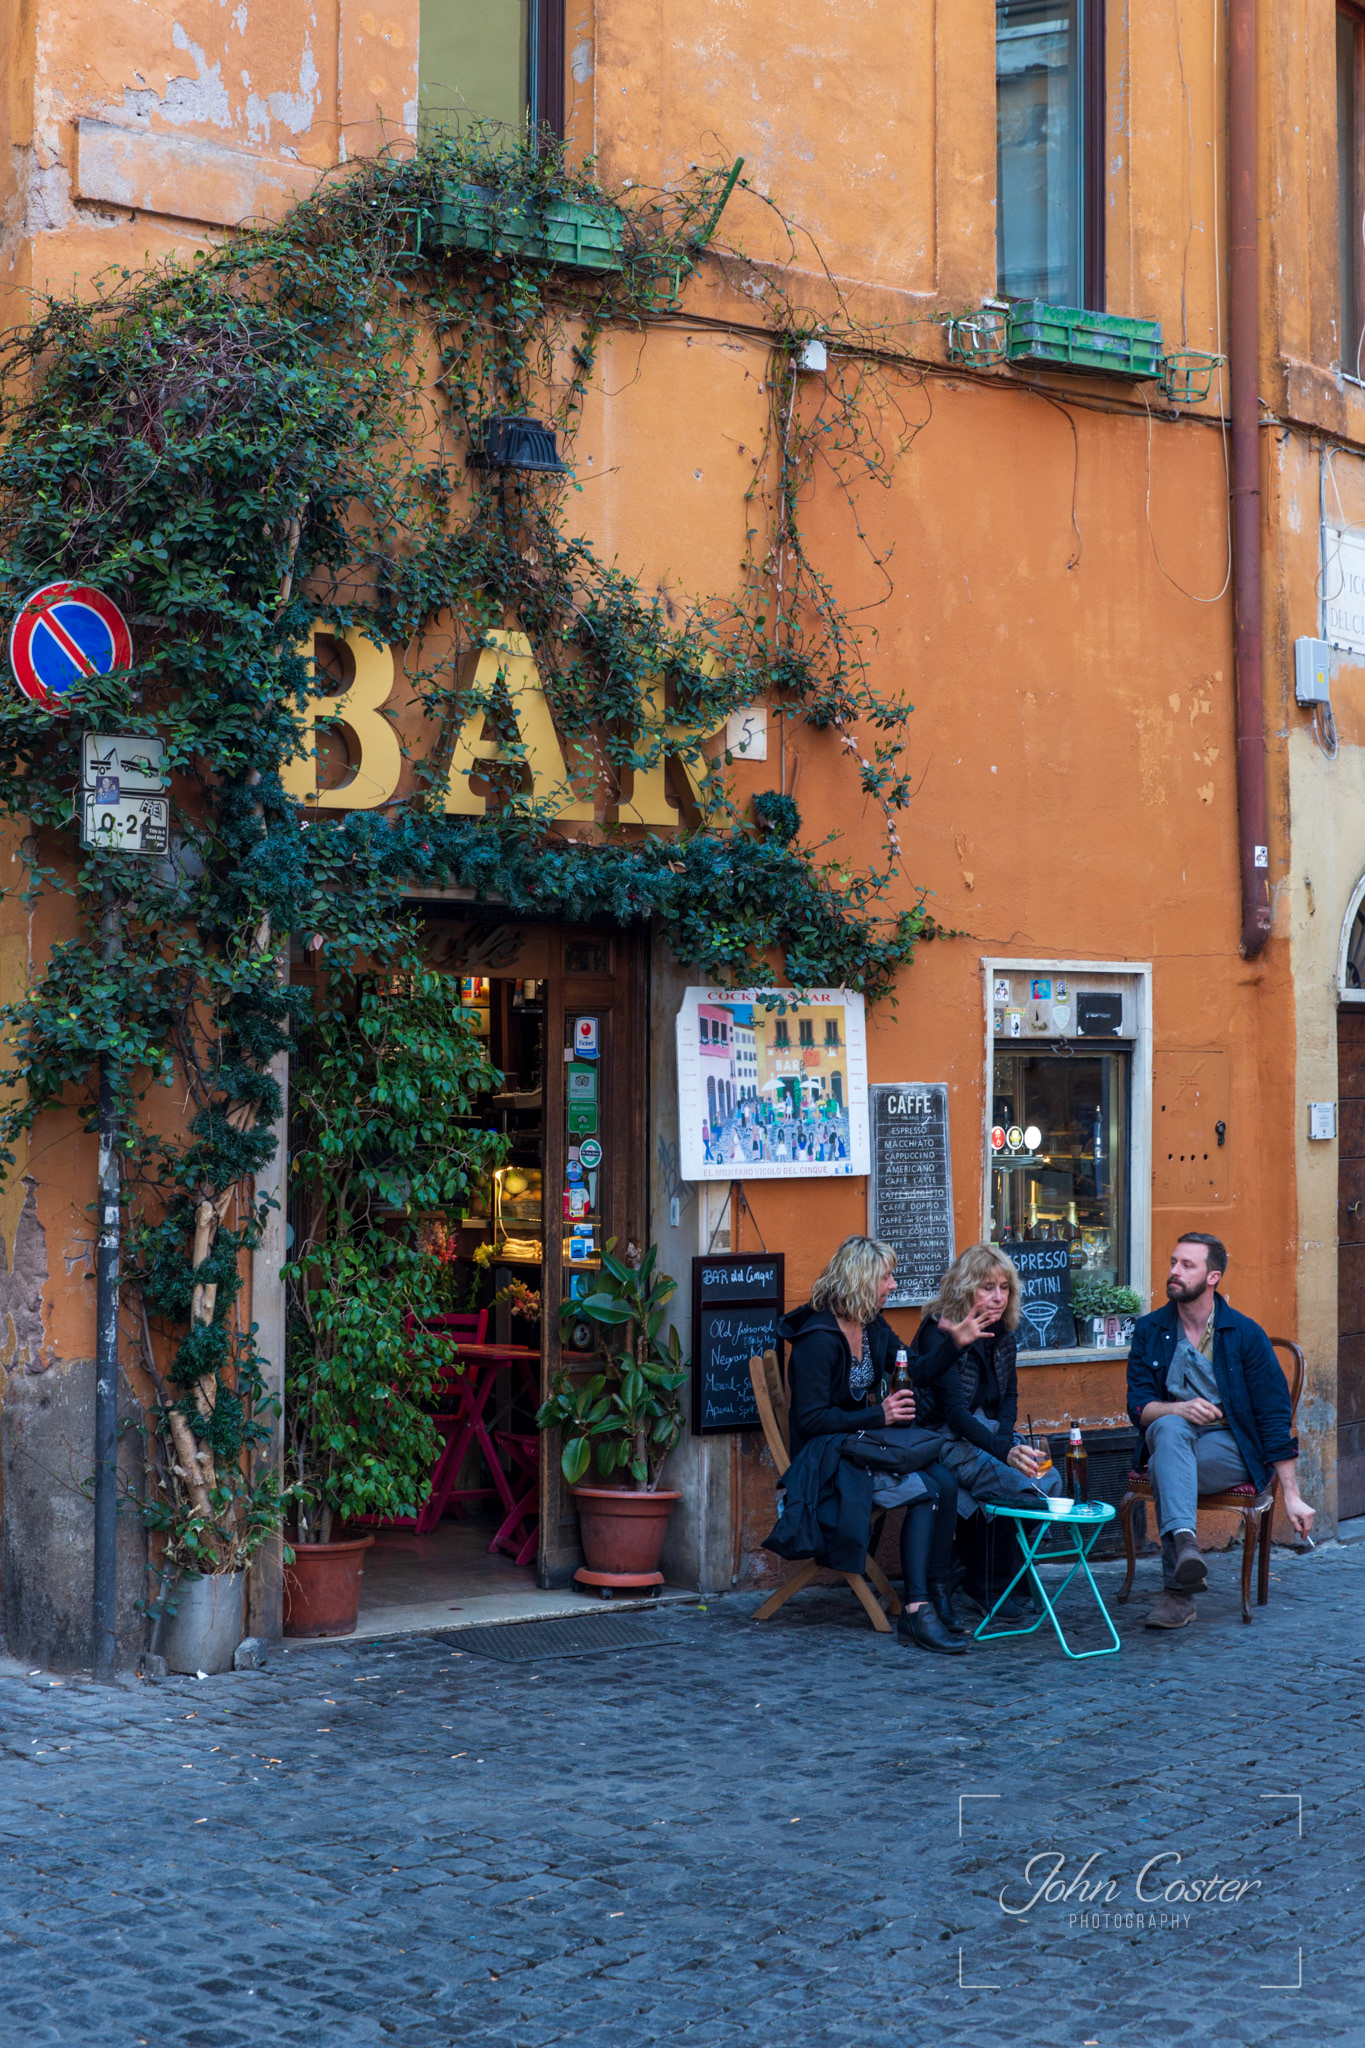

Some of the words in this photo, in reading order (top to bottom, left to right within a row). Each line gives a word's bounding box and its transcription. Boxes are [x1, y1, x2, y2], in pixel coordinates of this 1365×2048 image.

[1331, 607, 1351, 632] DEL
[278, 616, 735, 830] BAR
[740, 717, 756, 750] 5
[775, 1058, 800, 1071] BAR
[891, 1126, 927, 1135] ESPRESSO
[884, 1139, 935, 1149] MACCHIATO
[884, 1151, 935, 1161] CAPPUCCINO
[703, 1169, 713, 1177] EL
[755, 1167, 781, 1176] VICOLO
[783, 1166, 798, 1175] DEL
[800, 1165, 828, 1174] CINQUE
[885, 1164, 935, 1174] AMERICANO
[913, 1176, 937, 1185] LATTE
[910, 1201, 940, 1210] DOPPIO
[909, 1226, 946, 1236] CORRETTO
[920, 1240, 945, 1248] PANNA
[913, 1252, 942, 1260] MOCHA
[914, 1264, 941, 1273] LUNGO
[702, 1269, 729, 1285] BAR
[1020, 1275, 1061, 1298] ARTINI
[709, 1319, 732, 1339] Old
